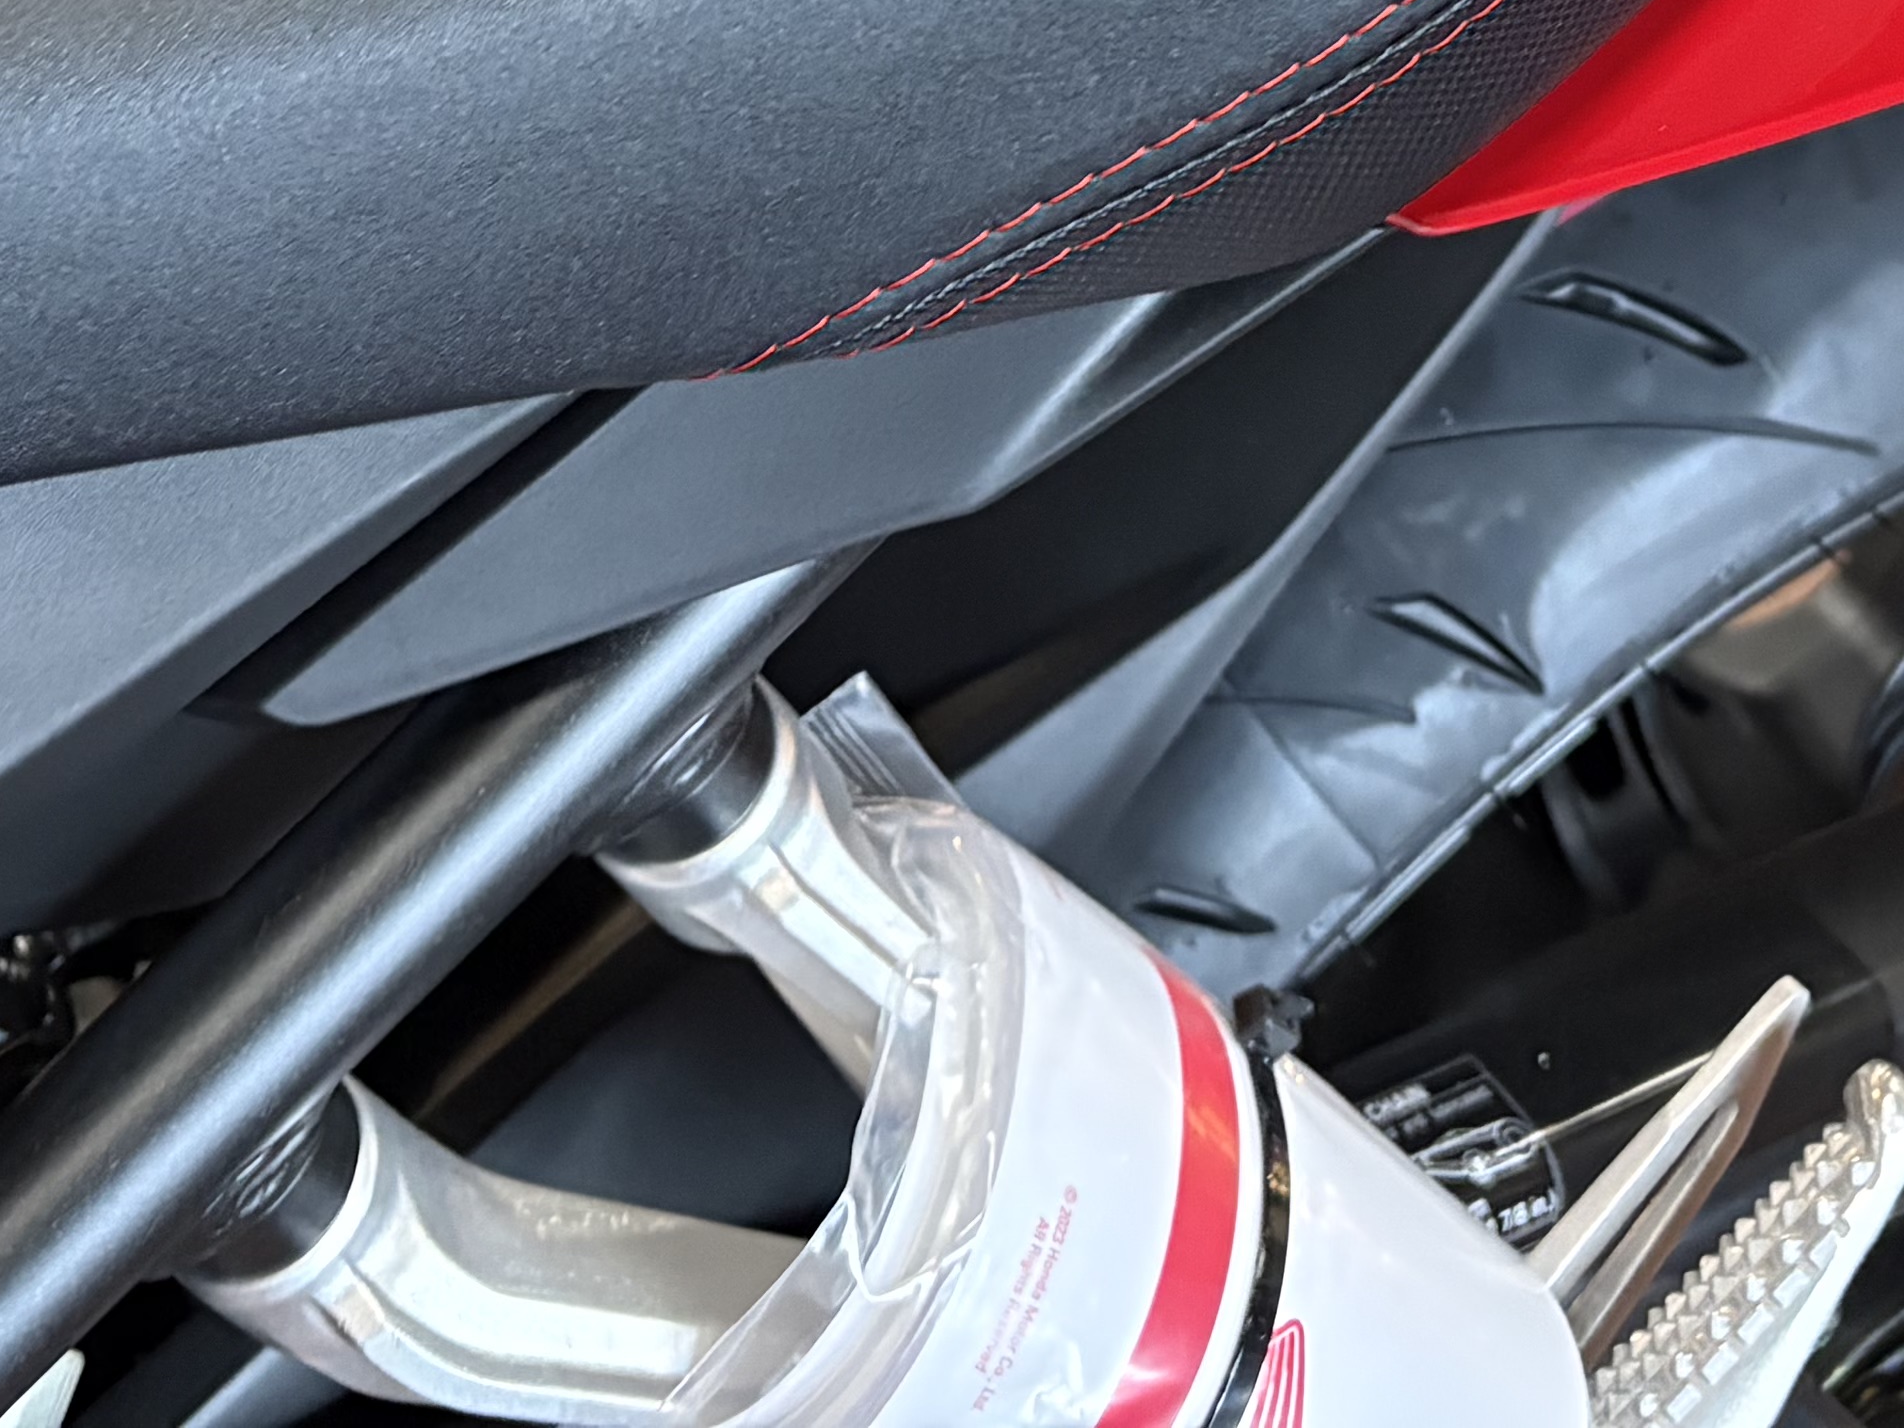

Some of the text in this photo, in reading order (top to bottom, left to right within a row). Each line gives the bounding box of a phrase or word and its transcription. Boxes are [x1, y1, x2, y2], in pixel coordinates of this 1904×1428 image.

[1053, 1205, 1072, 1245] 2023
[1013, 1243, 1042, 1295] Rights
[1031, 1247, 1061, 1301] Honda
[1007, 1305, 1039, 1354] Motor
